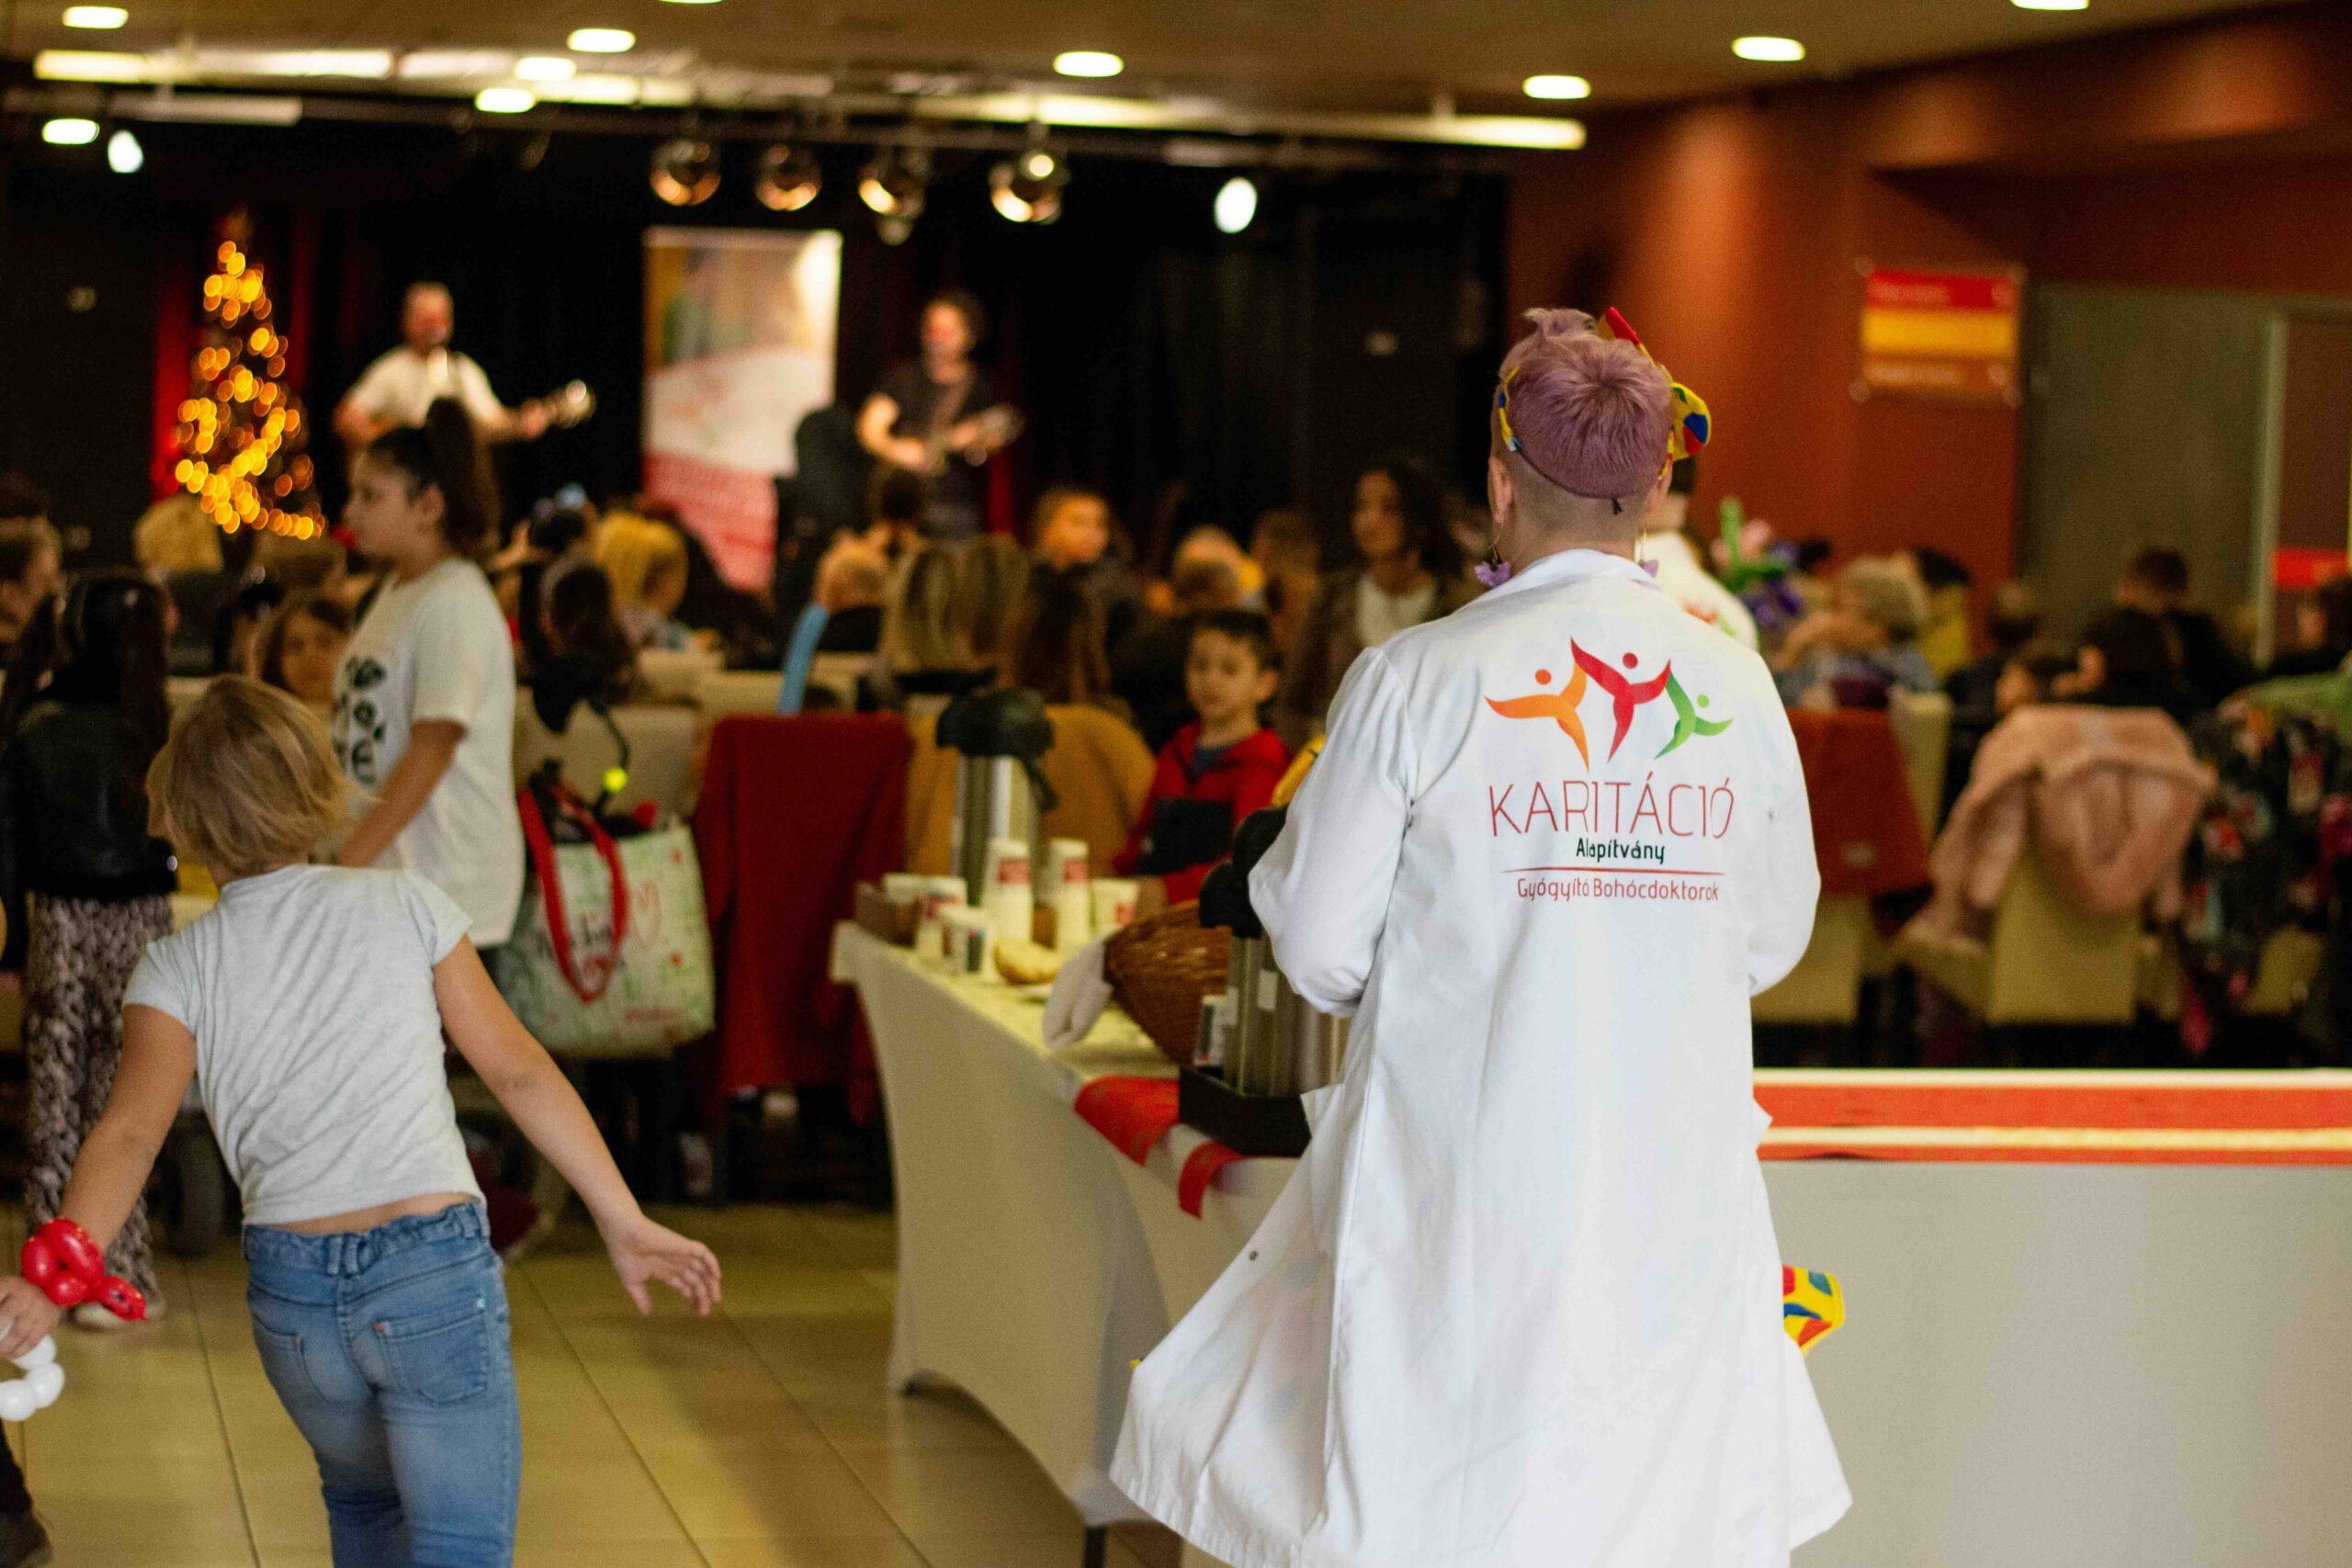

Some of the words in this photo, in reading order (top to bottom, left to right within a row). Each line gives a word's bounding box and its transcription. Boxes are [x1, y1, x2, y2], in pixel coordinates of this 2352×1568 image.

[1488, 771, 1735, 840] KARITÁCIÓ
[1576, 837, 1666, 864] Alapítvány
[1517, 877, 1589, 901] Gyógyító
[1593, 877, 1720, 901] Bohócdoktorok
